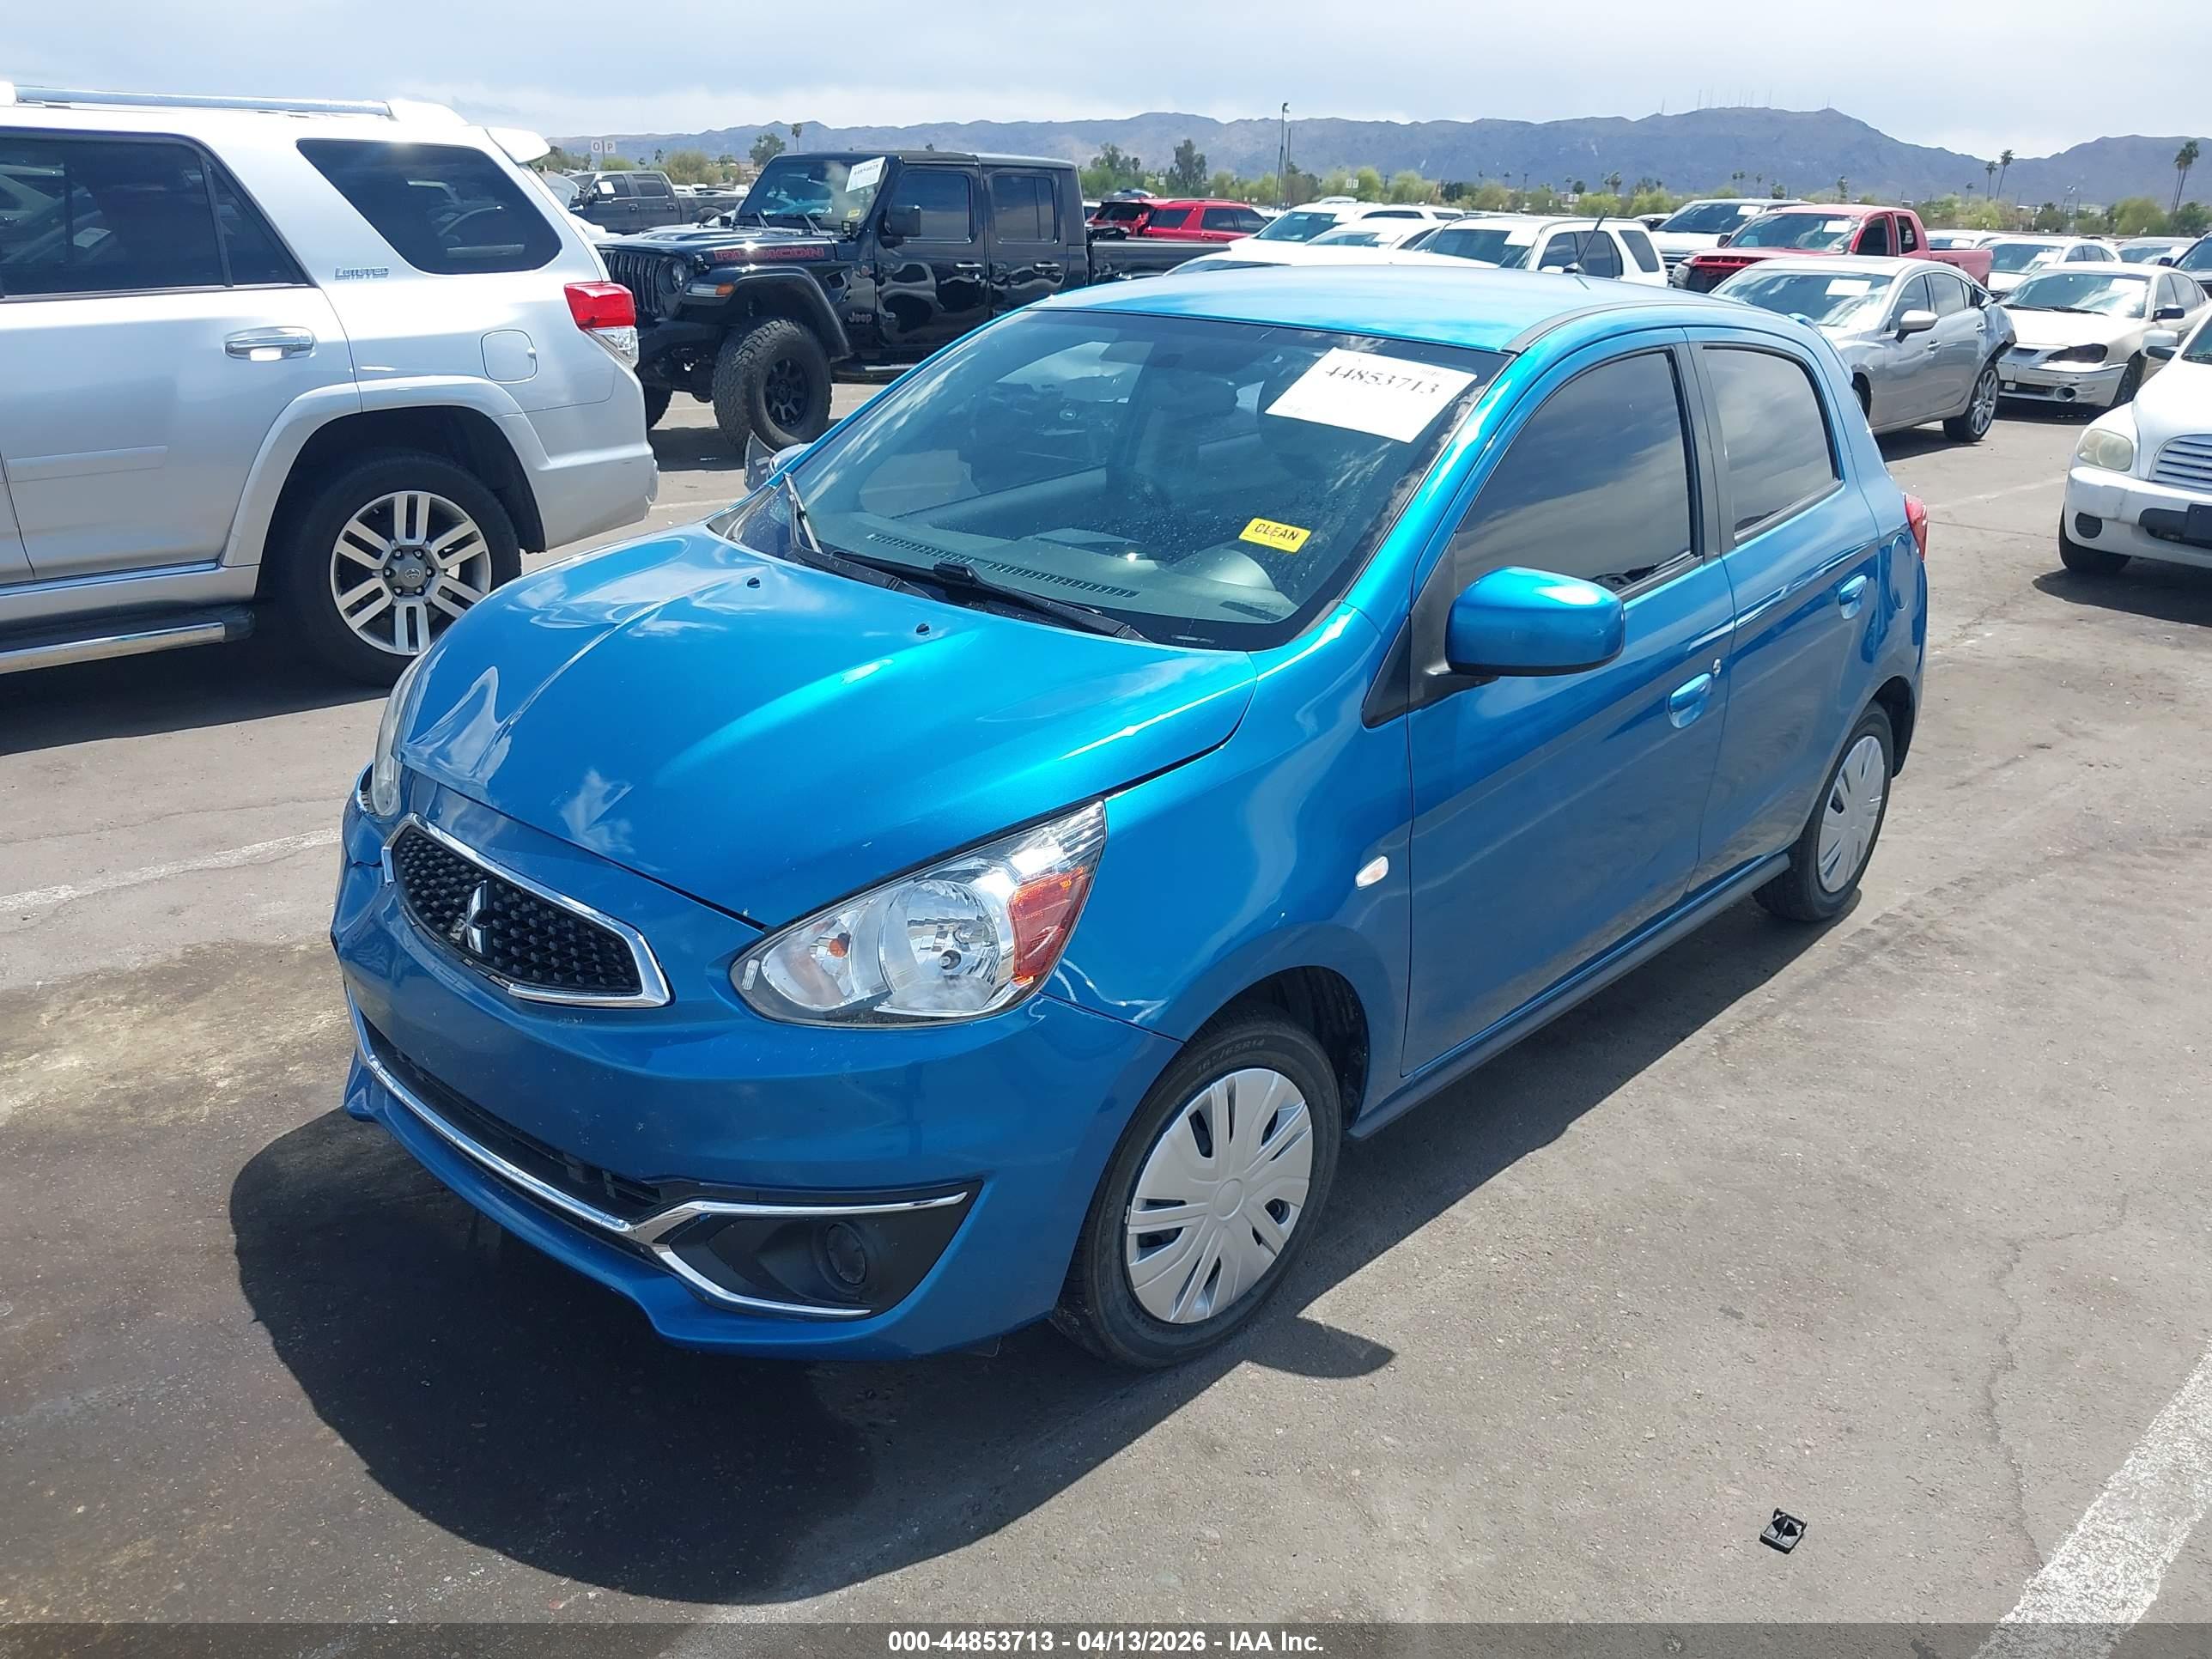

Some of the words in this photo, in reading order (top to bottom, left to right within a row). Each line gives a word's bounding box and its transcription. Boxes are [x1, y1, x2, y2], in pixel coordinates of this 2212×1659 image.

[607, 143, 613, 151] P
[848, 312, 872, 325] Jeep
[1325, 365, 1440, 394] 44853713
[1254, 522, 1299, 541] CLEAN
